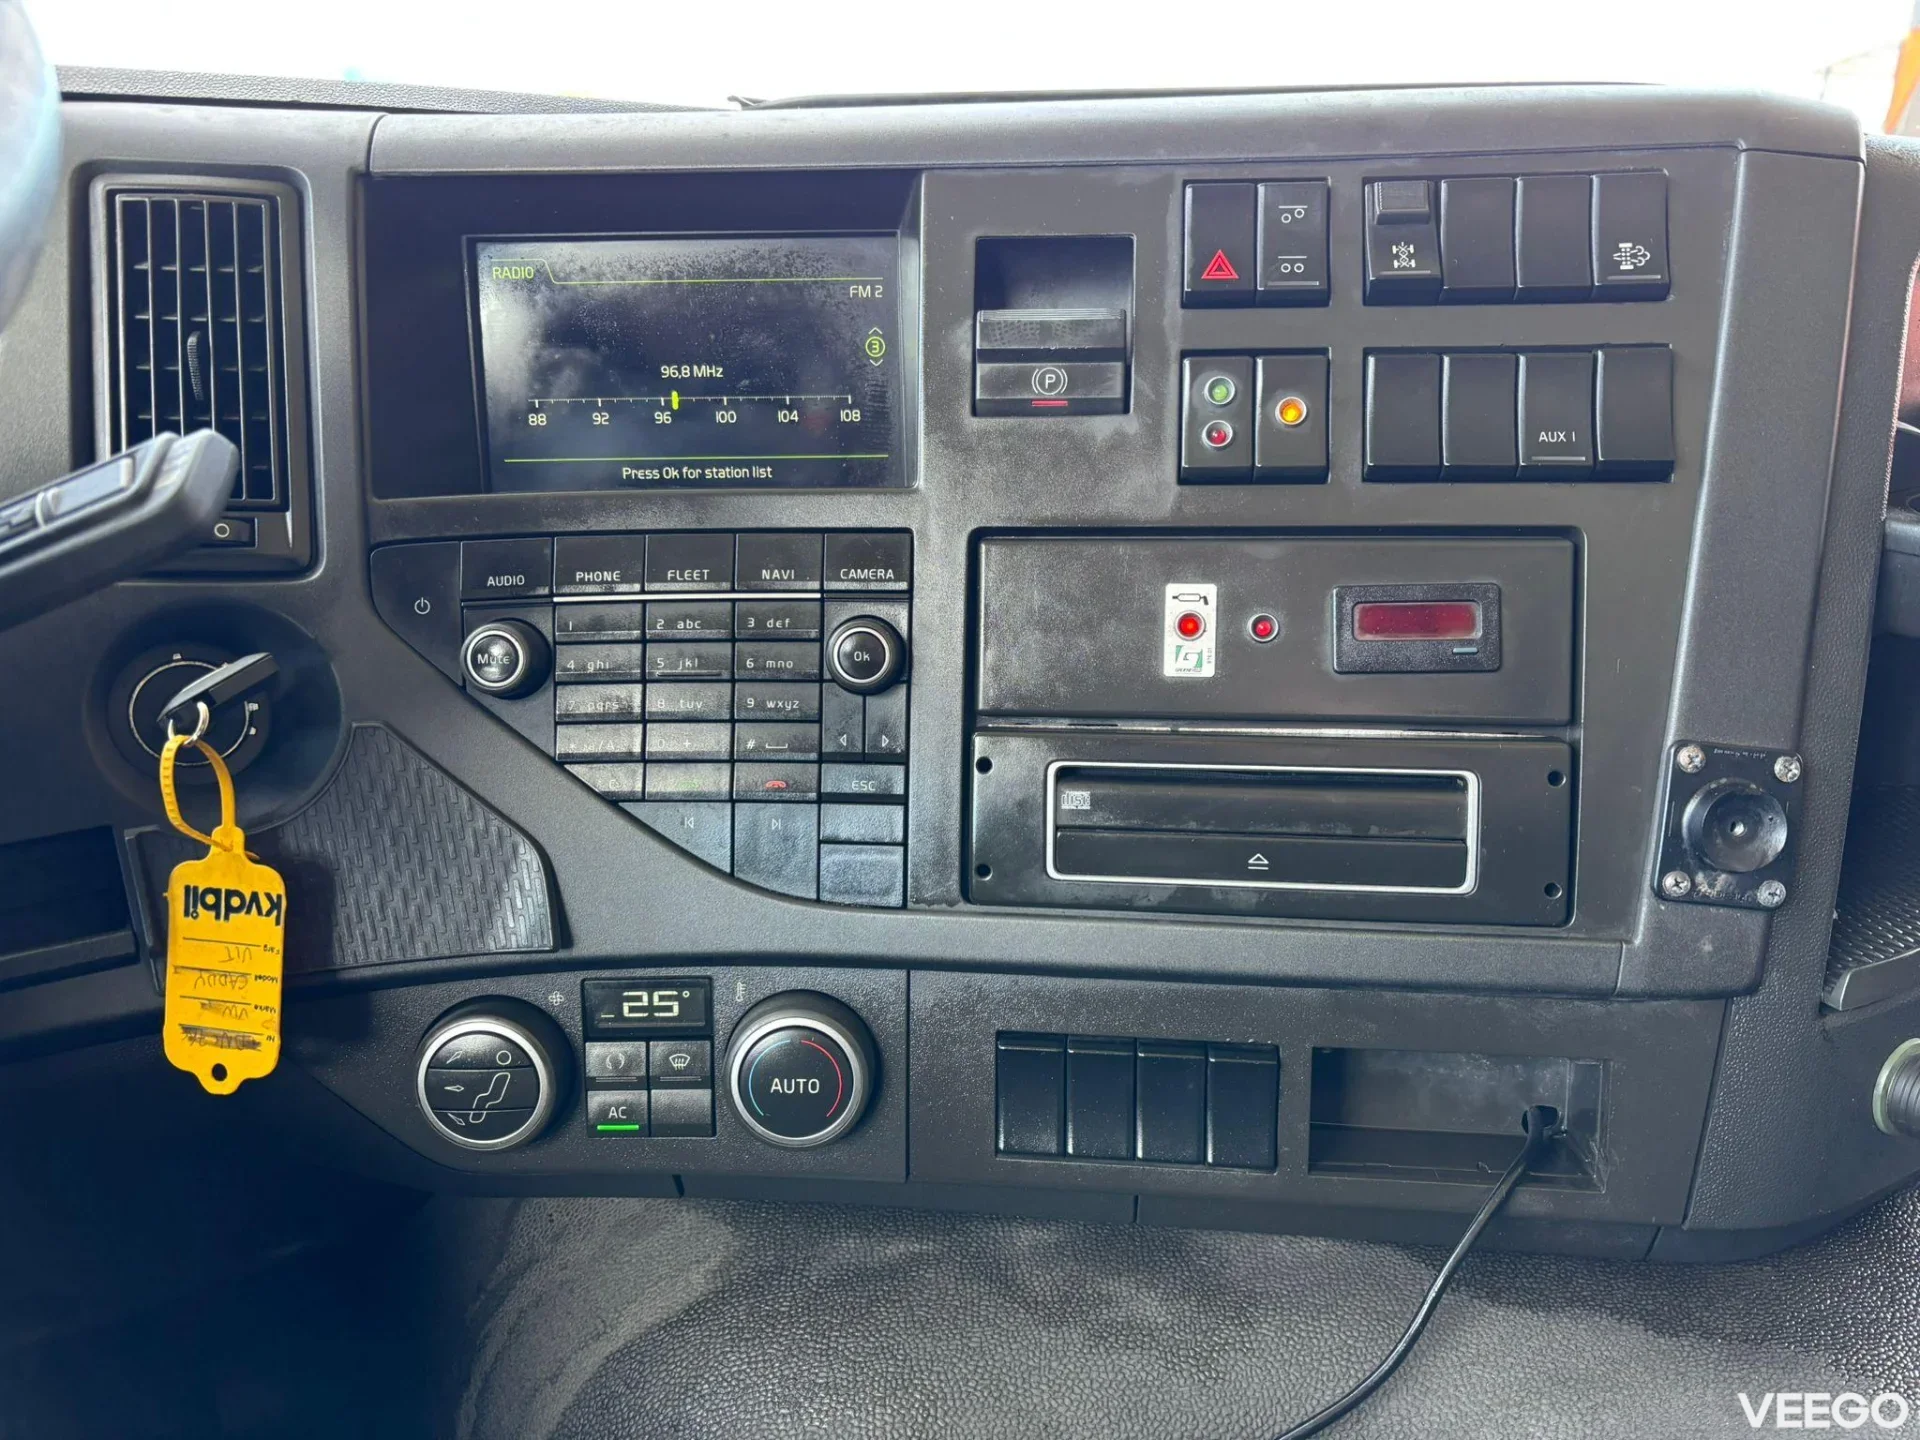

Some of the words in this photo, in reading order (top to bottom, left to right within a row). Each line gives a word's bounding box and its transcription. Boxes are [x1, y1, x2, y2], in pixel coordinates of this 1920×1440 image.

[492, 266, 534, 280] RADIO
[850, 285, 871, 298] FM
[874, 285, 883, 298] 2
[693, 364, 724, 378] MHz
[528, 414, 547, 426] 88
[592, 413, 610, 425] 92
[654, 412, 672, 424] 96
[715, 411, 737, 423] 100
[777, 411, 799, 423] 104
[840, 410, 861, 422] 108
[1538, 431, 1567, 443] AUX
[622, 467, 660, 479] Press
[682, 466, 702, 479] for
[705, 466, 750, 479] station
[752, 466, 773, 478] list
[486, 574, 525, 587] AUDIO
[575, 570, 621, 582] PHONE
[667, 569, 710, 581] FLEET
[761, 569, 796, 580] NAVI
[839, 568, 895, 581] CAMERA
[656, 619, 665, 630] 2
[676, 619, 702, 630] abc
[746, 617, 755, 628] 3
[766, 617, 791, 629] def
[477, 652, 511, 666] Mute
[853, 650, 871, 662] Ok
[566, 659, 576, 670] 4
[586, 660, 610, 674] ghi
[656, 657, 665, 669] 5
[677, 657, 699, 671] jkl
[746, 658, 755, 669] 6
[766, 659, 794, 669] mno
[656, 698, 666, 709] 8
[678, 698, 704, 709] tuv
[746, 698, 755, 708] 9
[766, 699, 800, 712] wxyz
[851, 780, 876, 791] ESC
[183, 885, 283, 927] kvdbil
[769, 1078, 821, 1095] AUTO
[608, 1106, 627, 1119] AC
